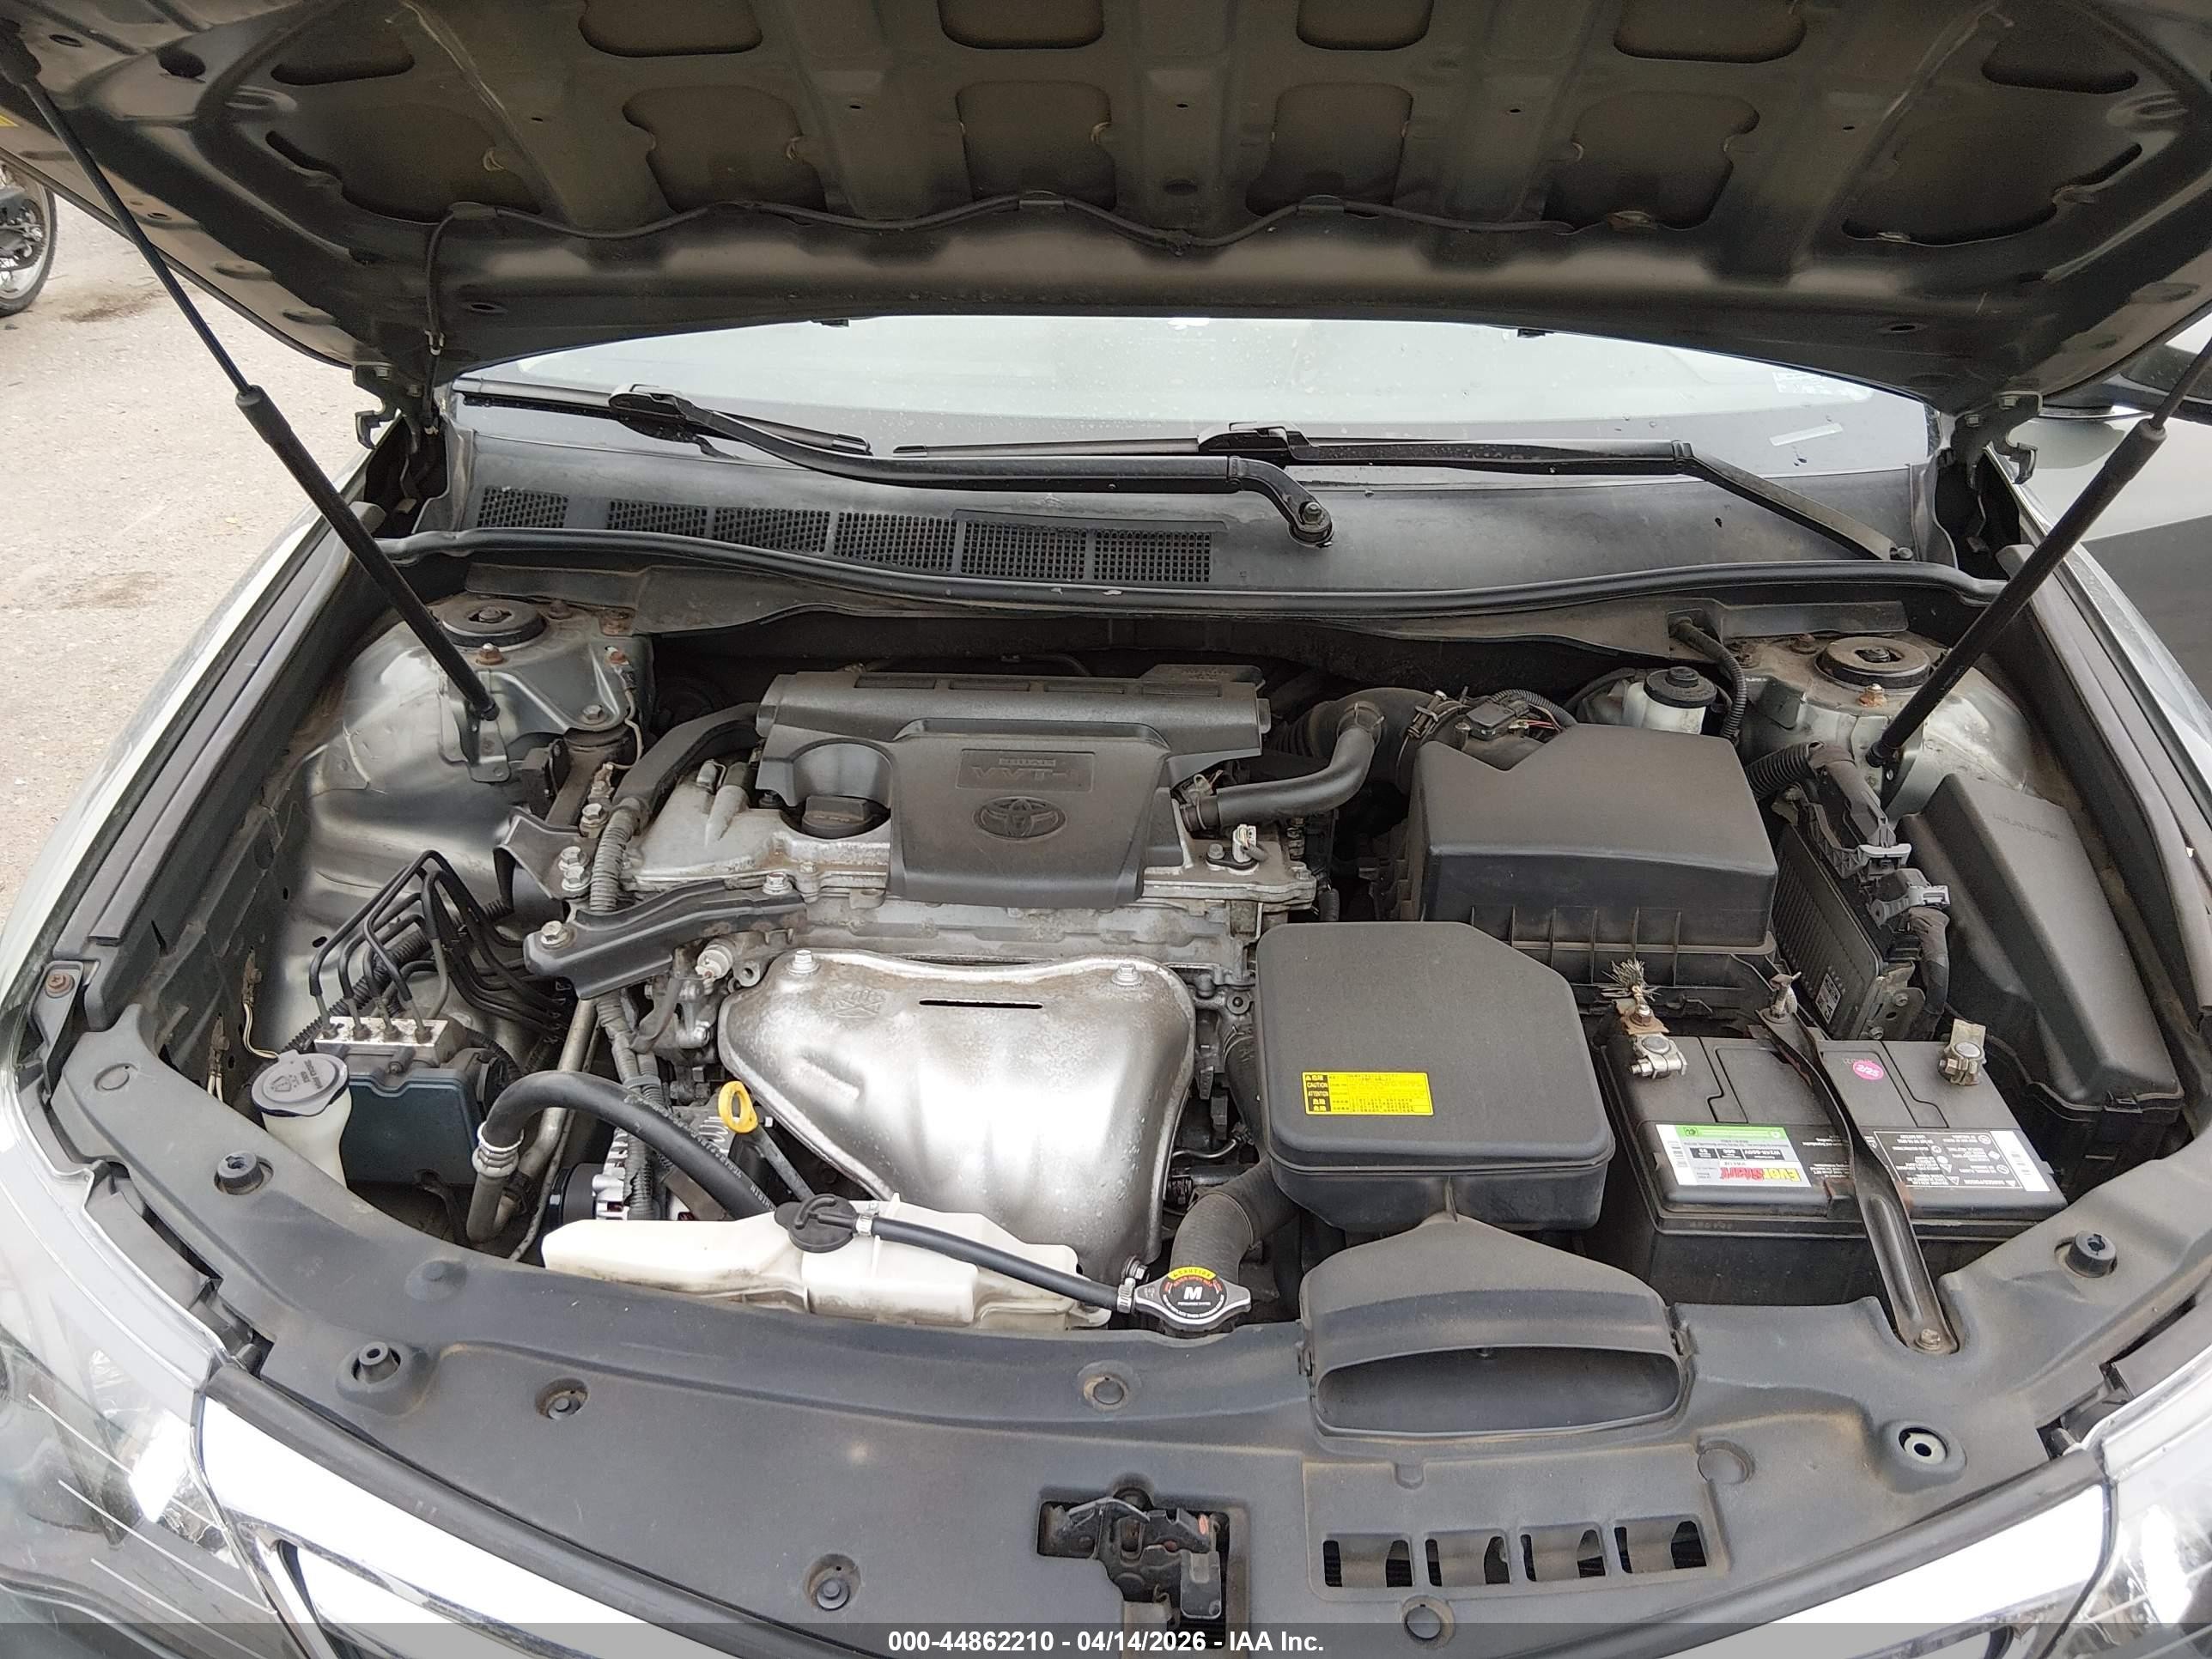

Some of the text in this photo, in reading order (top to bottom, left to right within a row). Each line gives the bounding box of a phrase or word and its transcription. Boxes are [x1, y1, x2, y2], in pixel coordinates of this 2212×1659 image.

[1721, 1168, 1801, 1182] EverStart
[1178, 1268, 1211, 1278] CAUTION
[1183, 1286, 1203, 1300] M
